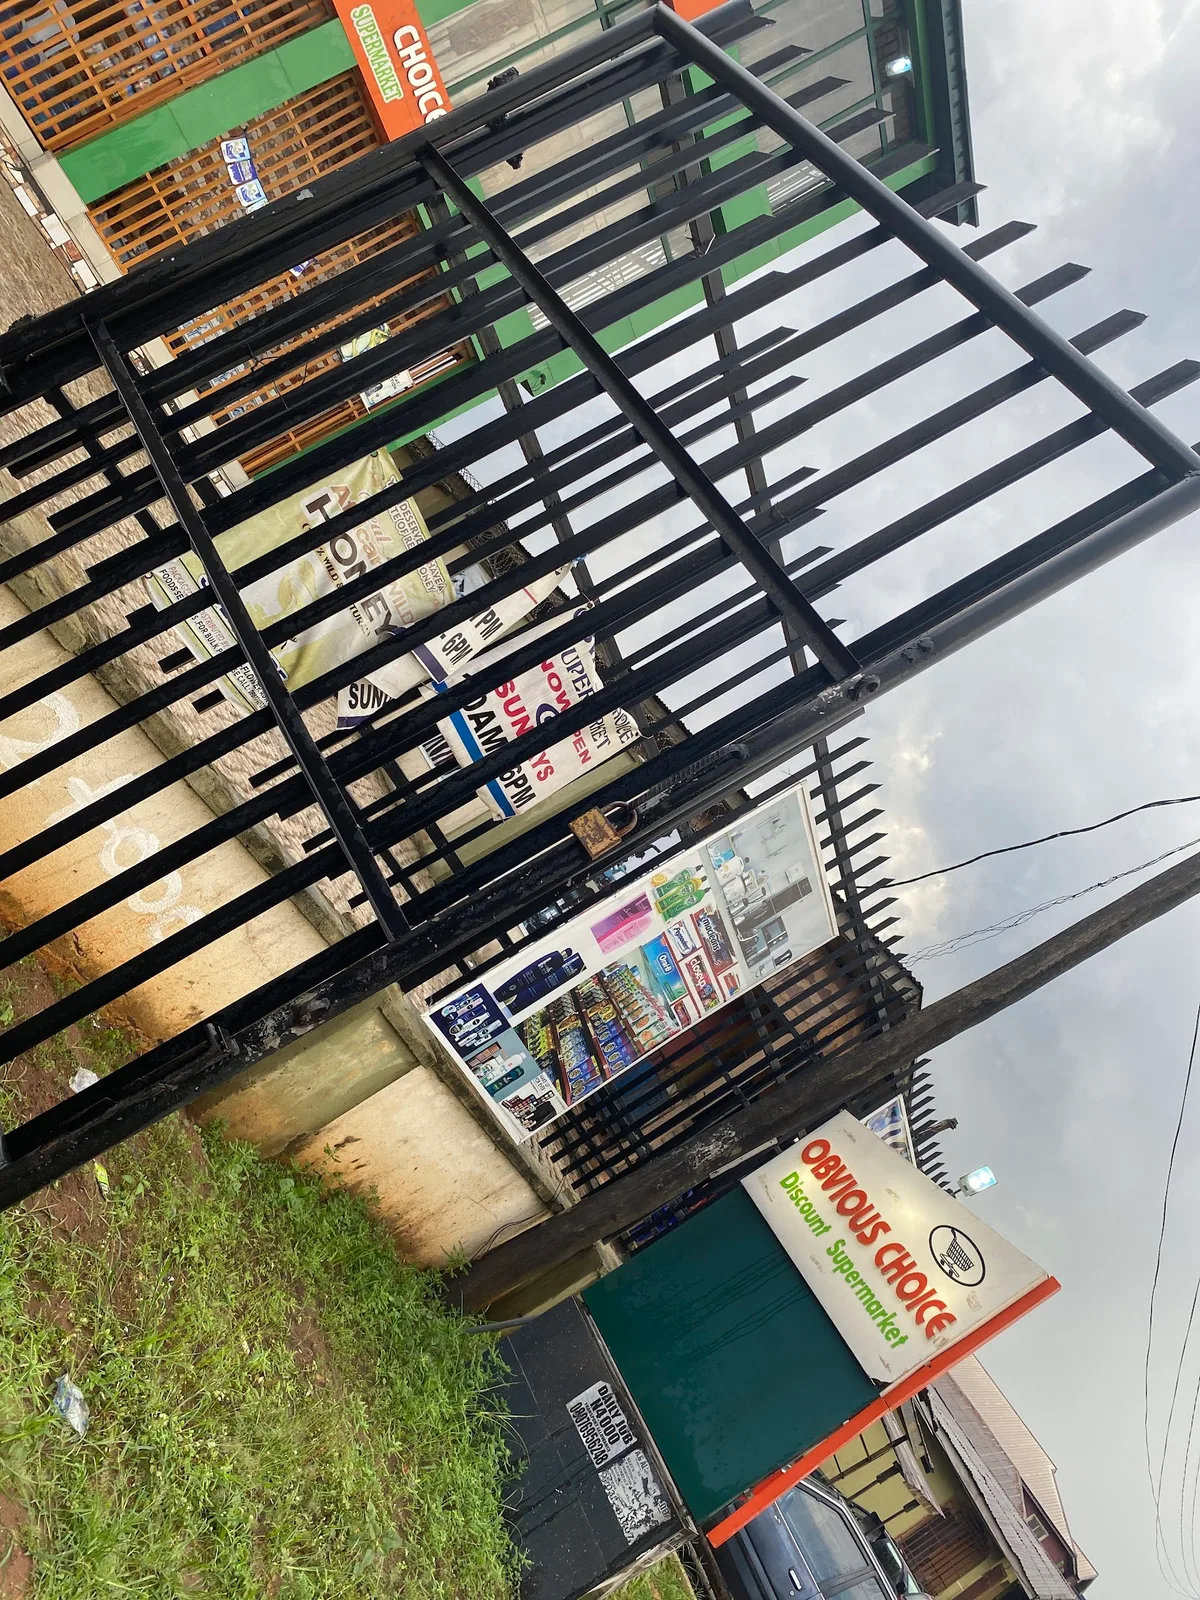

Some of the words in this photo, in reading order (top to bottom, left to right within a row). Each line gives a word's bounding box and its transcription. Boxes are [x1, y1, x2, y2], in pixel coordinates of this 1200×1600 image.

[353, 5, 401, 101] SUPERMARKET
[321, 556, 339, 581] WILD
[396, 519, 408, 536] OF
[418, 566, 436, 592] ONEY
[159, 568, 177, 591] FOODS
[204, 632, 218, 649] BULK
[442, 633, 473, 665] 6PM
[494, 679, 555, 782] SUNYS
[539, 659, 572, 711] NOW
[570, 730, 591, 764] PEN
[499, 764, 536, 808] 6PM
[659, 953, 671, 971] Oral-B
[702, 918, 719, 951] macleans
[688, 959, 705, 985] closeup
[779, 1171, 832, 1238] Discount
[825, 1238, 910, 1350] Supermarket
[801, 1139, 891, 1246] OBVIOUS
[876, 1243, 957, 1342] CHOICE
[597, 1384, 621, 1419] DAILY
[614, 1419, 633, 1444] JOB
